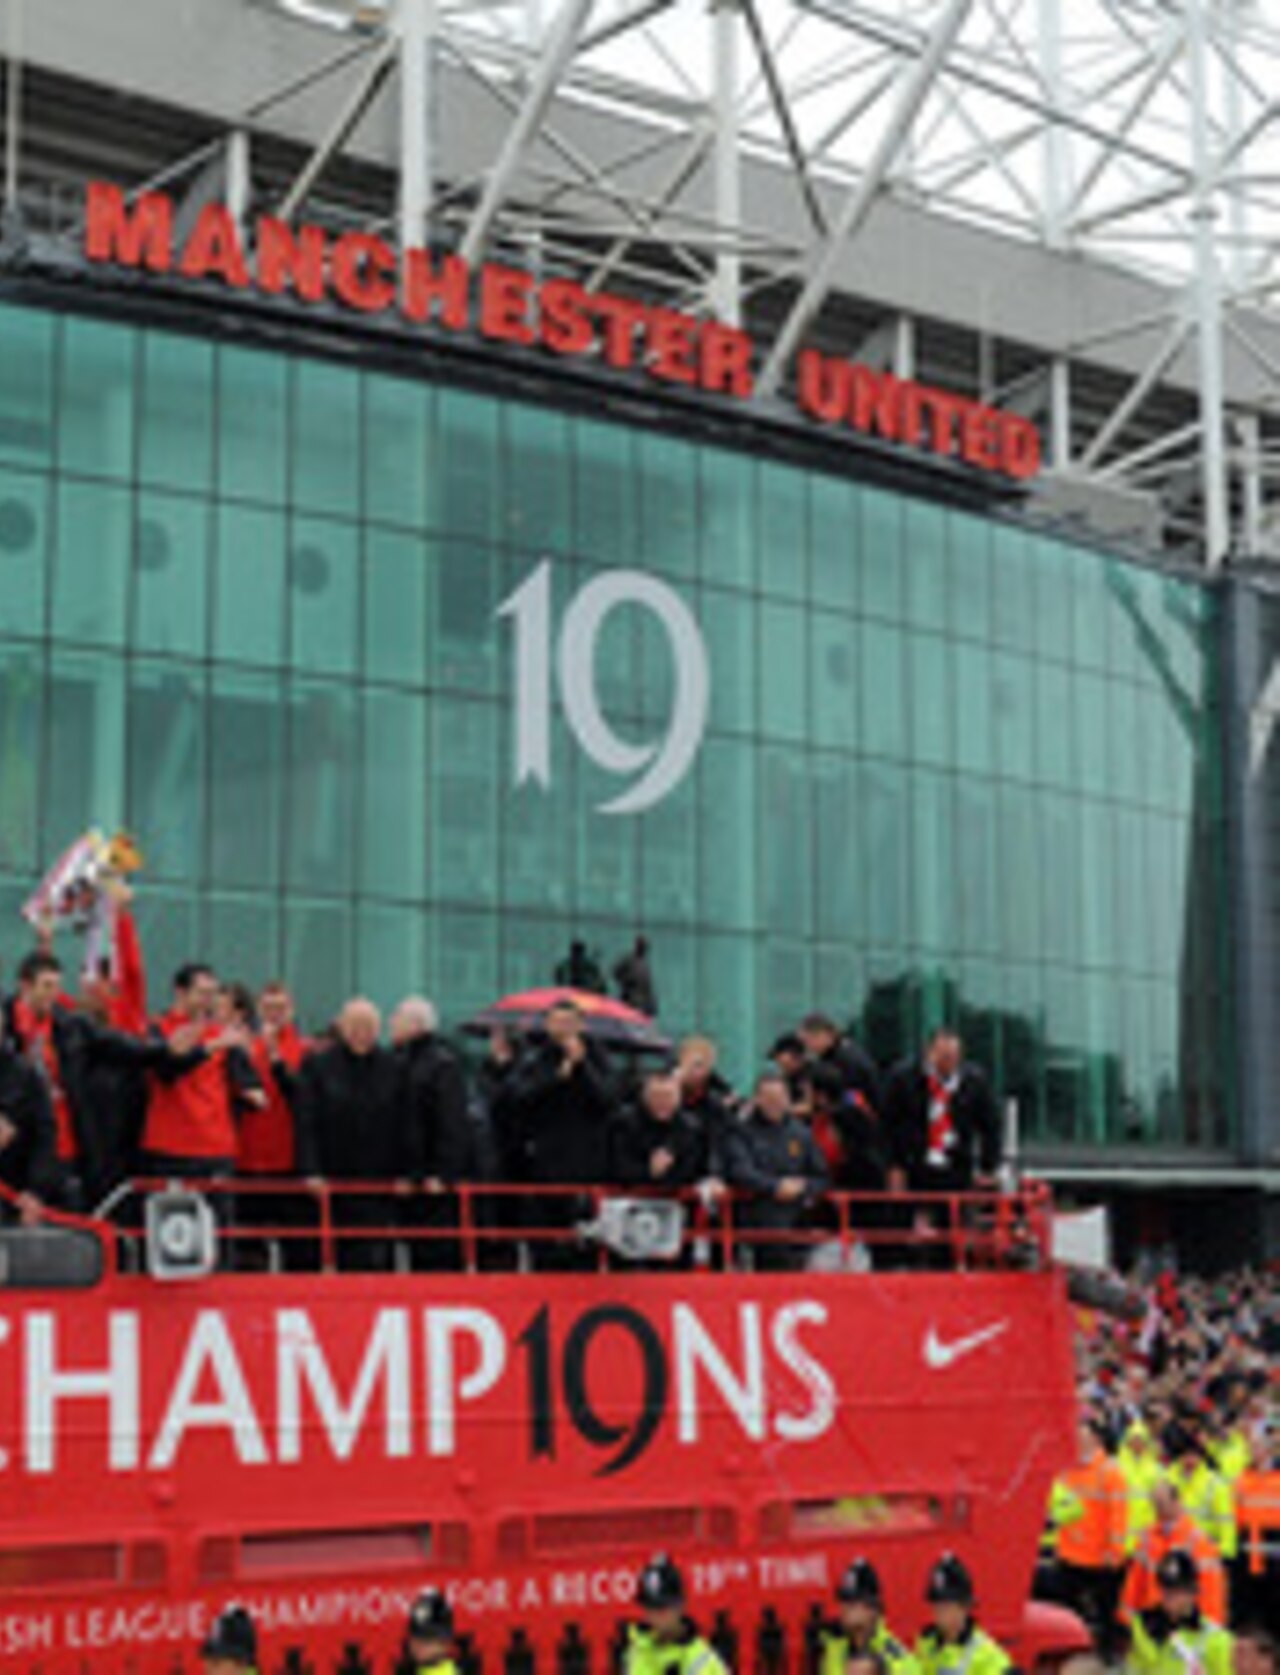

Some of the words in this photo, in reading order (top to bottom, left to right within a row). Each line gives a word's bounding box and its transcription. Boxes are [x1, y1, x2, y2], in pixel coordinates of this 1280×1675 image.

[83, 181, 755, 398] MANCHESTER
[799, 347, 1043, 478] UNITED
[492, 557, 710, 814] 19
[66, 1602, 206, 1648] LEAGUE
[446, 1575, 512, 1615] FOR
[519, 1578, 542, 1609] A
[550, 1570, 640, 1607] RECO
[758, 1554, 828, 1588] TIME
